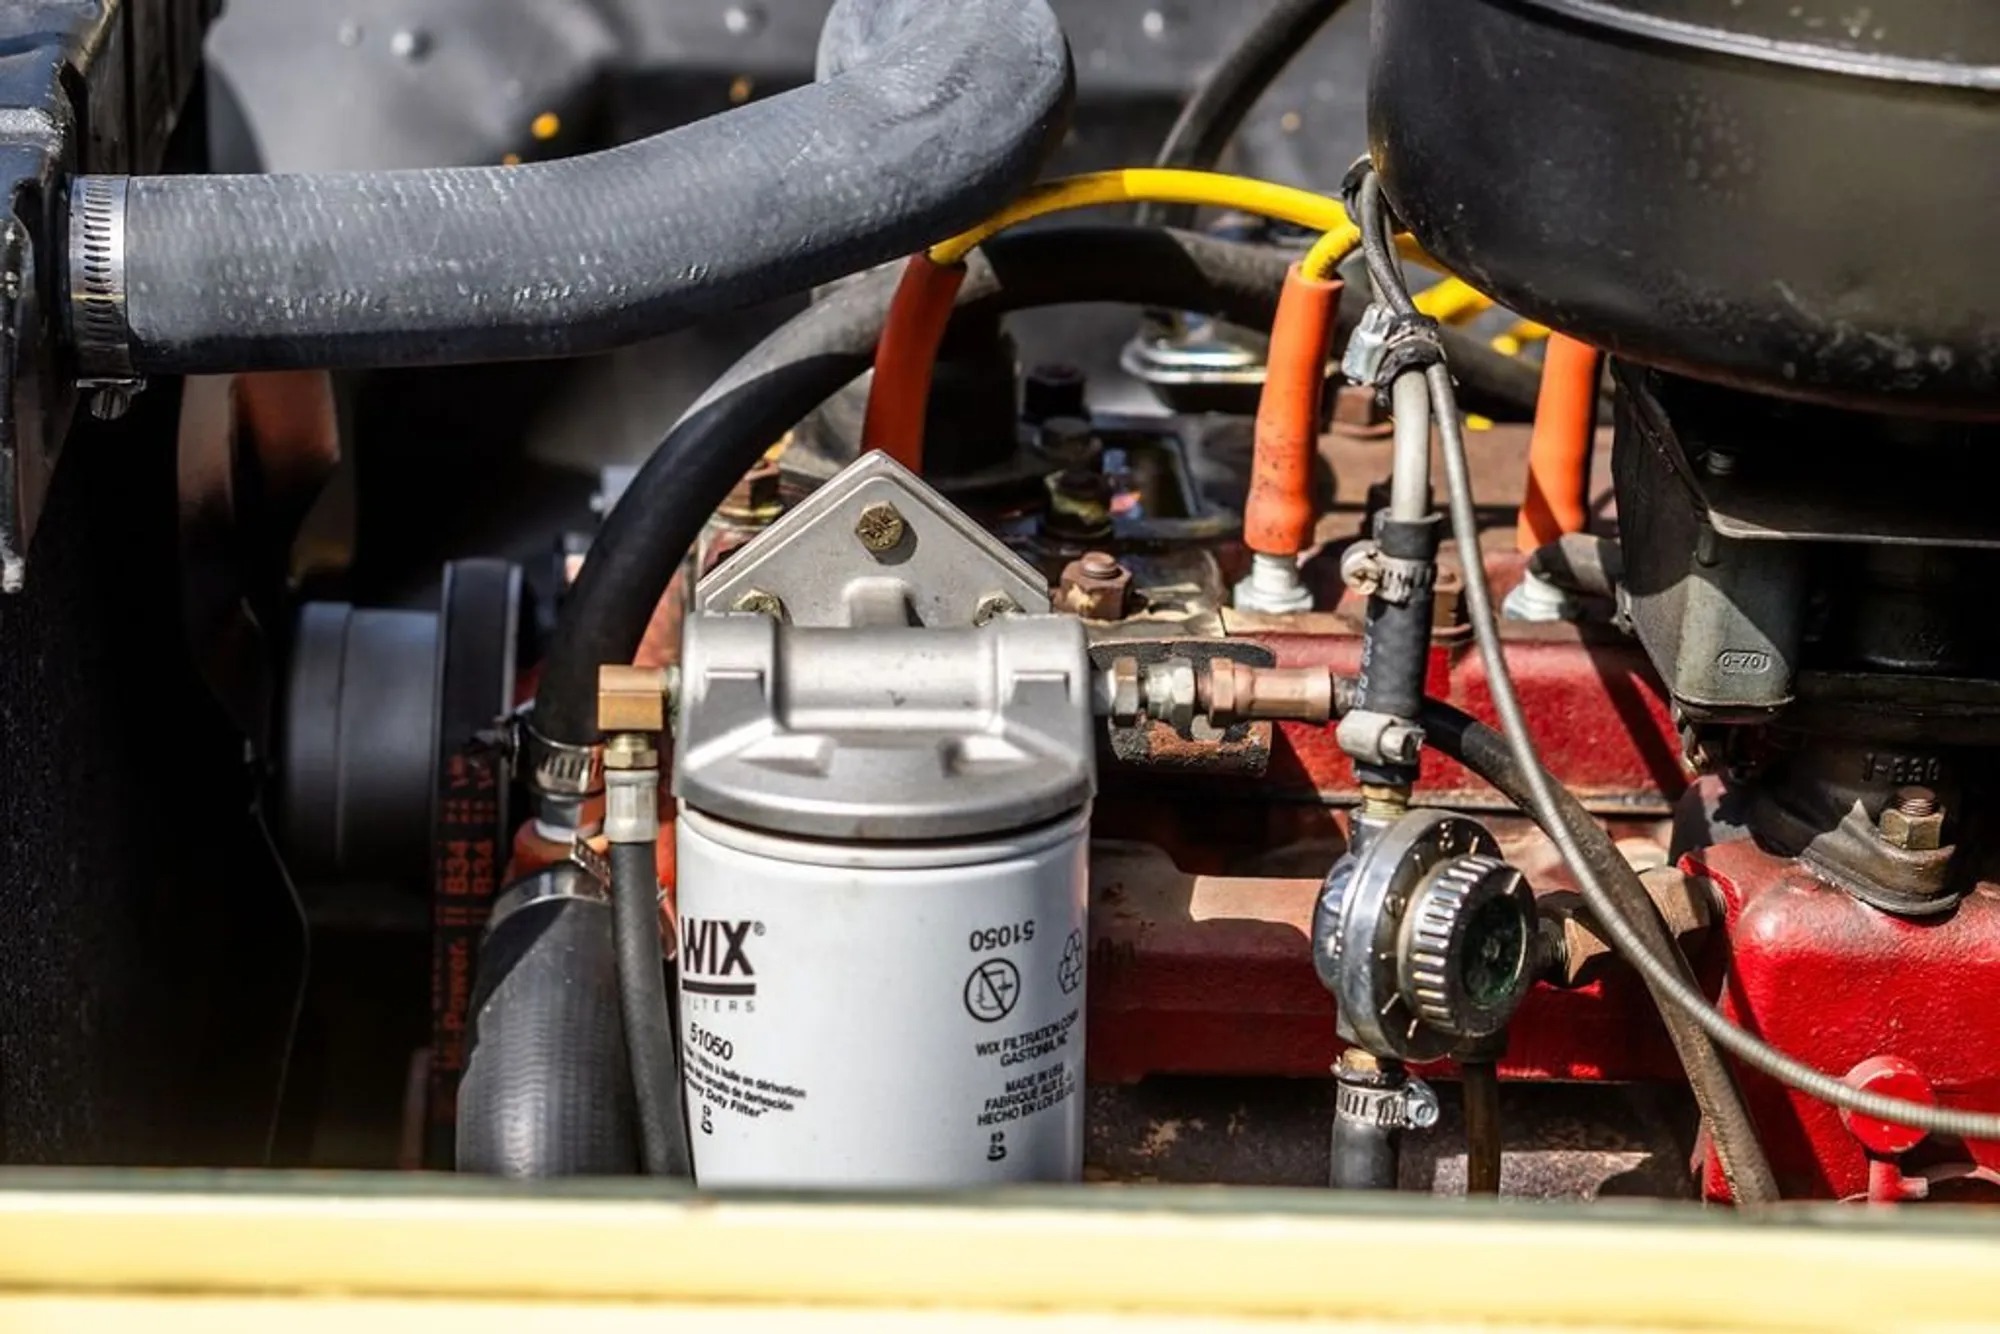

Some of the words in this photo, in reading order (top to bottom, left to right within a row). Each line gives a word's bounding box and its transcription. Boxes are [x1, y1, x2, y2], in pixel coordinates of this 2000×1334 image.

[680, 914, 754, 976] WIX
[968, 919, 1035, 952] 51050
[690, 1021, 734, 1061] 51050
[975, 1040, 1002, 1057] WIX
[705, 1087, 727, 1109] Duty
[977, 1106, 1020, 1126] HECHO
[1021, 1101, 1037, 1118] EN
